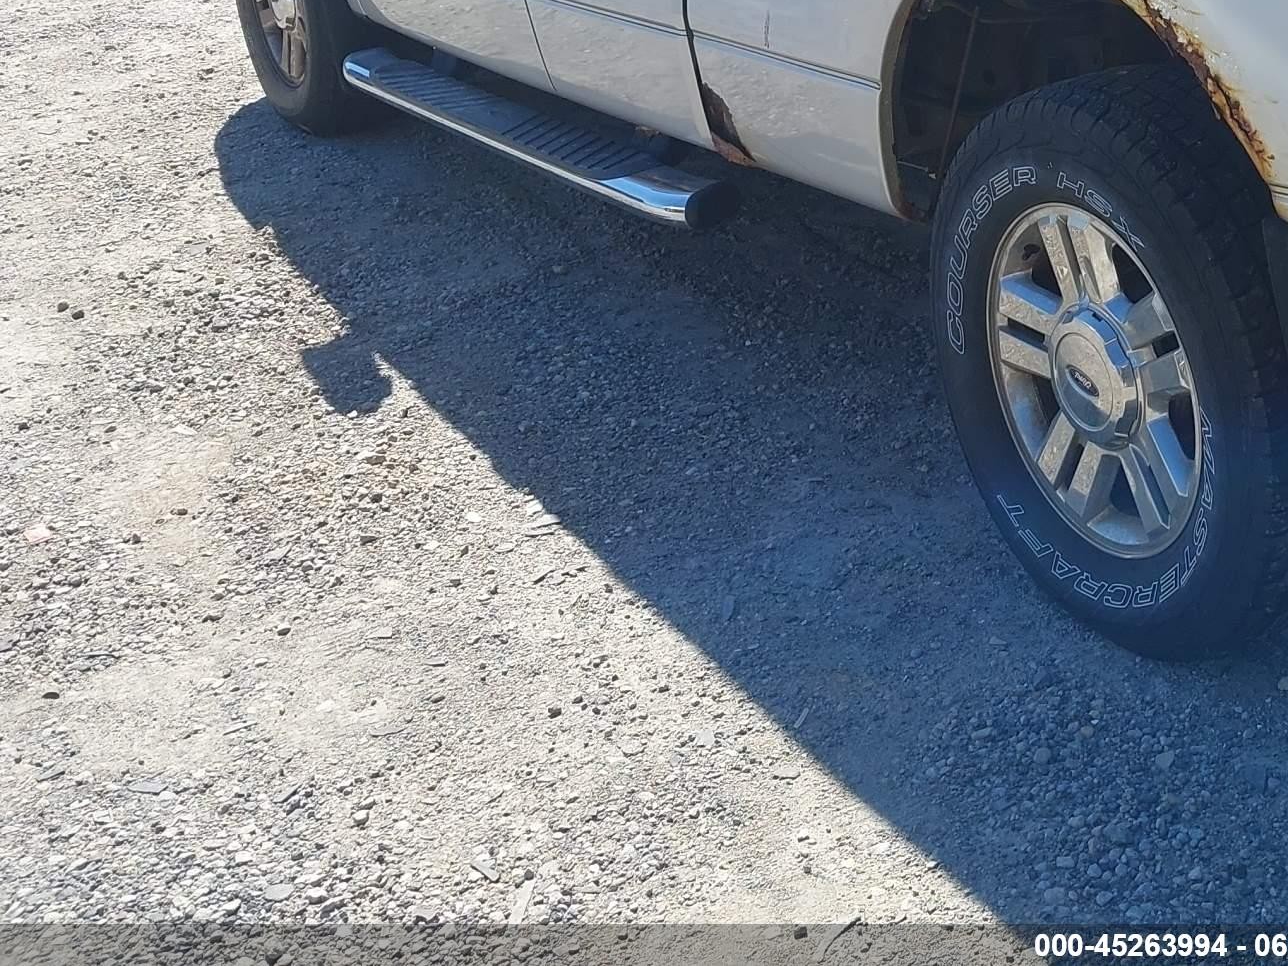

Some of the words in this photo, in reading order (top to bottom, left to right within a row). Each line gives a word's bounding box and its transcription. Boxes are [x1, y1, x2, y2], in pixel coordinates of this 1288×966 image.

[946, 165, 1037, 355] COURSER
[1056, 171, 1145, 253] HSX
[996, 405, 1216, 609] MASTERCRAFT
